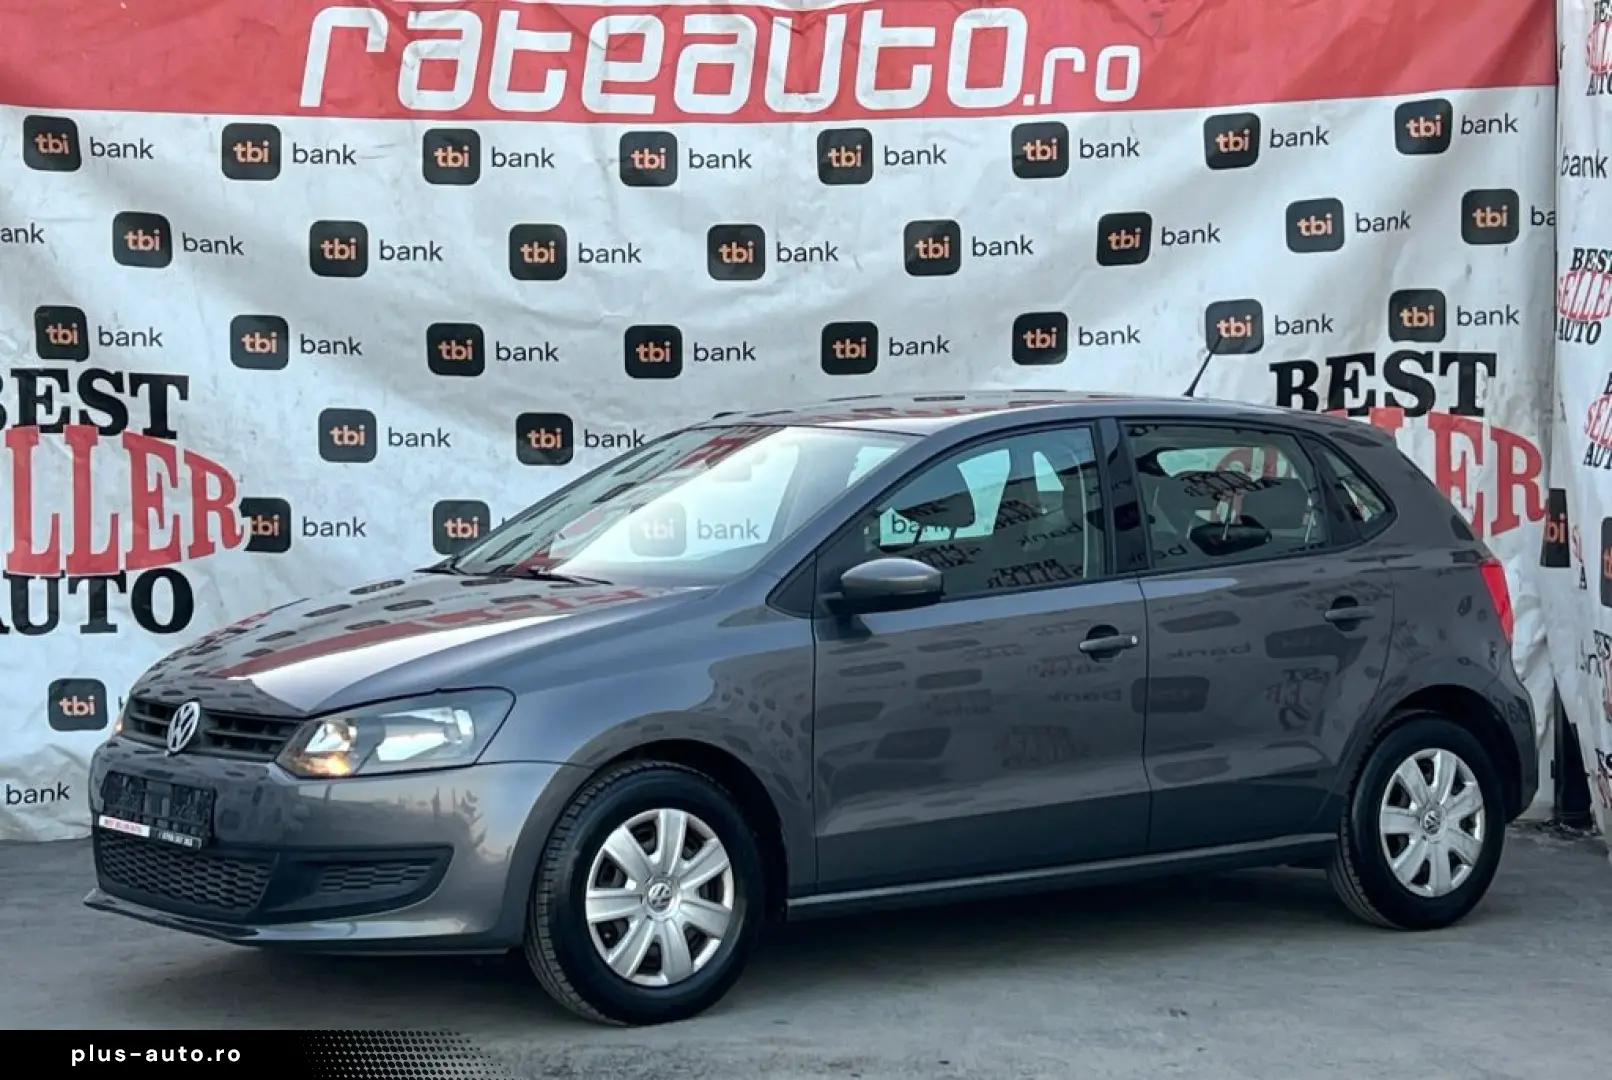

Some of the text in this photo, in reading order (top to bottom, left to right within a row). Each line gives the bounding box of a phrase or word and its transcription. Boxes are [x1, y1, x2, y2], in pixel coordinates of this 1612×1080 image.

[300, 6, 1141, 115] rateauto.ro
[1405, 113, 1519, 138] tbi bank
[34, 132, 154, 160] tbi bank
[1022, 137, 1141, 161] tbi bank
[1215, 126, 1329, 153] tbi bank
[233, 139, 357, 166] tbi bank
[434, 145, 555, 169] tbi bank
[631, 147, 753, 170] tbi bank
[828, 144, 947, 168] tbi bank
[1560, 148, 1609, 178] bank
[1296, 209, 1412, 237] tbi bank
[1471, 205, 1508, 228] tbi
[124, 229, 245, 256] tbi bank
[915, 234, 1034, 259] tbi bank
[1107, 221, 1222, 251] tbi bank
[320, 237, 444, 262] tbi bank
[520, 240, 642, 264] tbi bank
[718, 240, 839, 264] tbi bank
[1216, 313, 1334, 338] tbi bank
[1400, 304, 1520, 328] tbi bank
[46, 323, 163, 348] tbi bank
[241, 331, 363, 357] tbi bank
[832, 335, 950, 359] tbi bank
[1022, 325, 1140, 349] tbi bank
[438, 339, 559, 363] tbi bank
[635, 340, 757, 363] tbi bank
[1269, 350, 1497, 418] BEST
[0, 367, 190, 439] EST
[330, 424, 452, 448] tbi bank
[527, 427, 646, 449] tbi bank
[302, 516, 366, 539] bank
[444, 516, 479, 538] tbi
[697, 518, 761, 541] bank
[0, 567, 196, 636] UTO
[59, 694, 95, 717] tbi
[6, 781, 71, 805] bank
